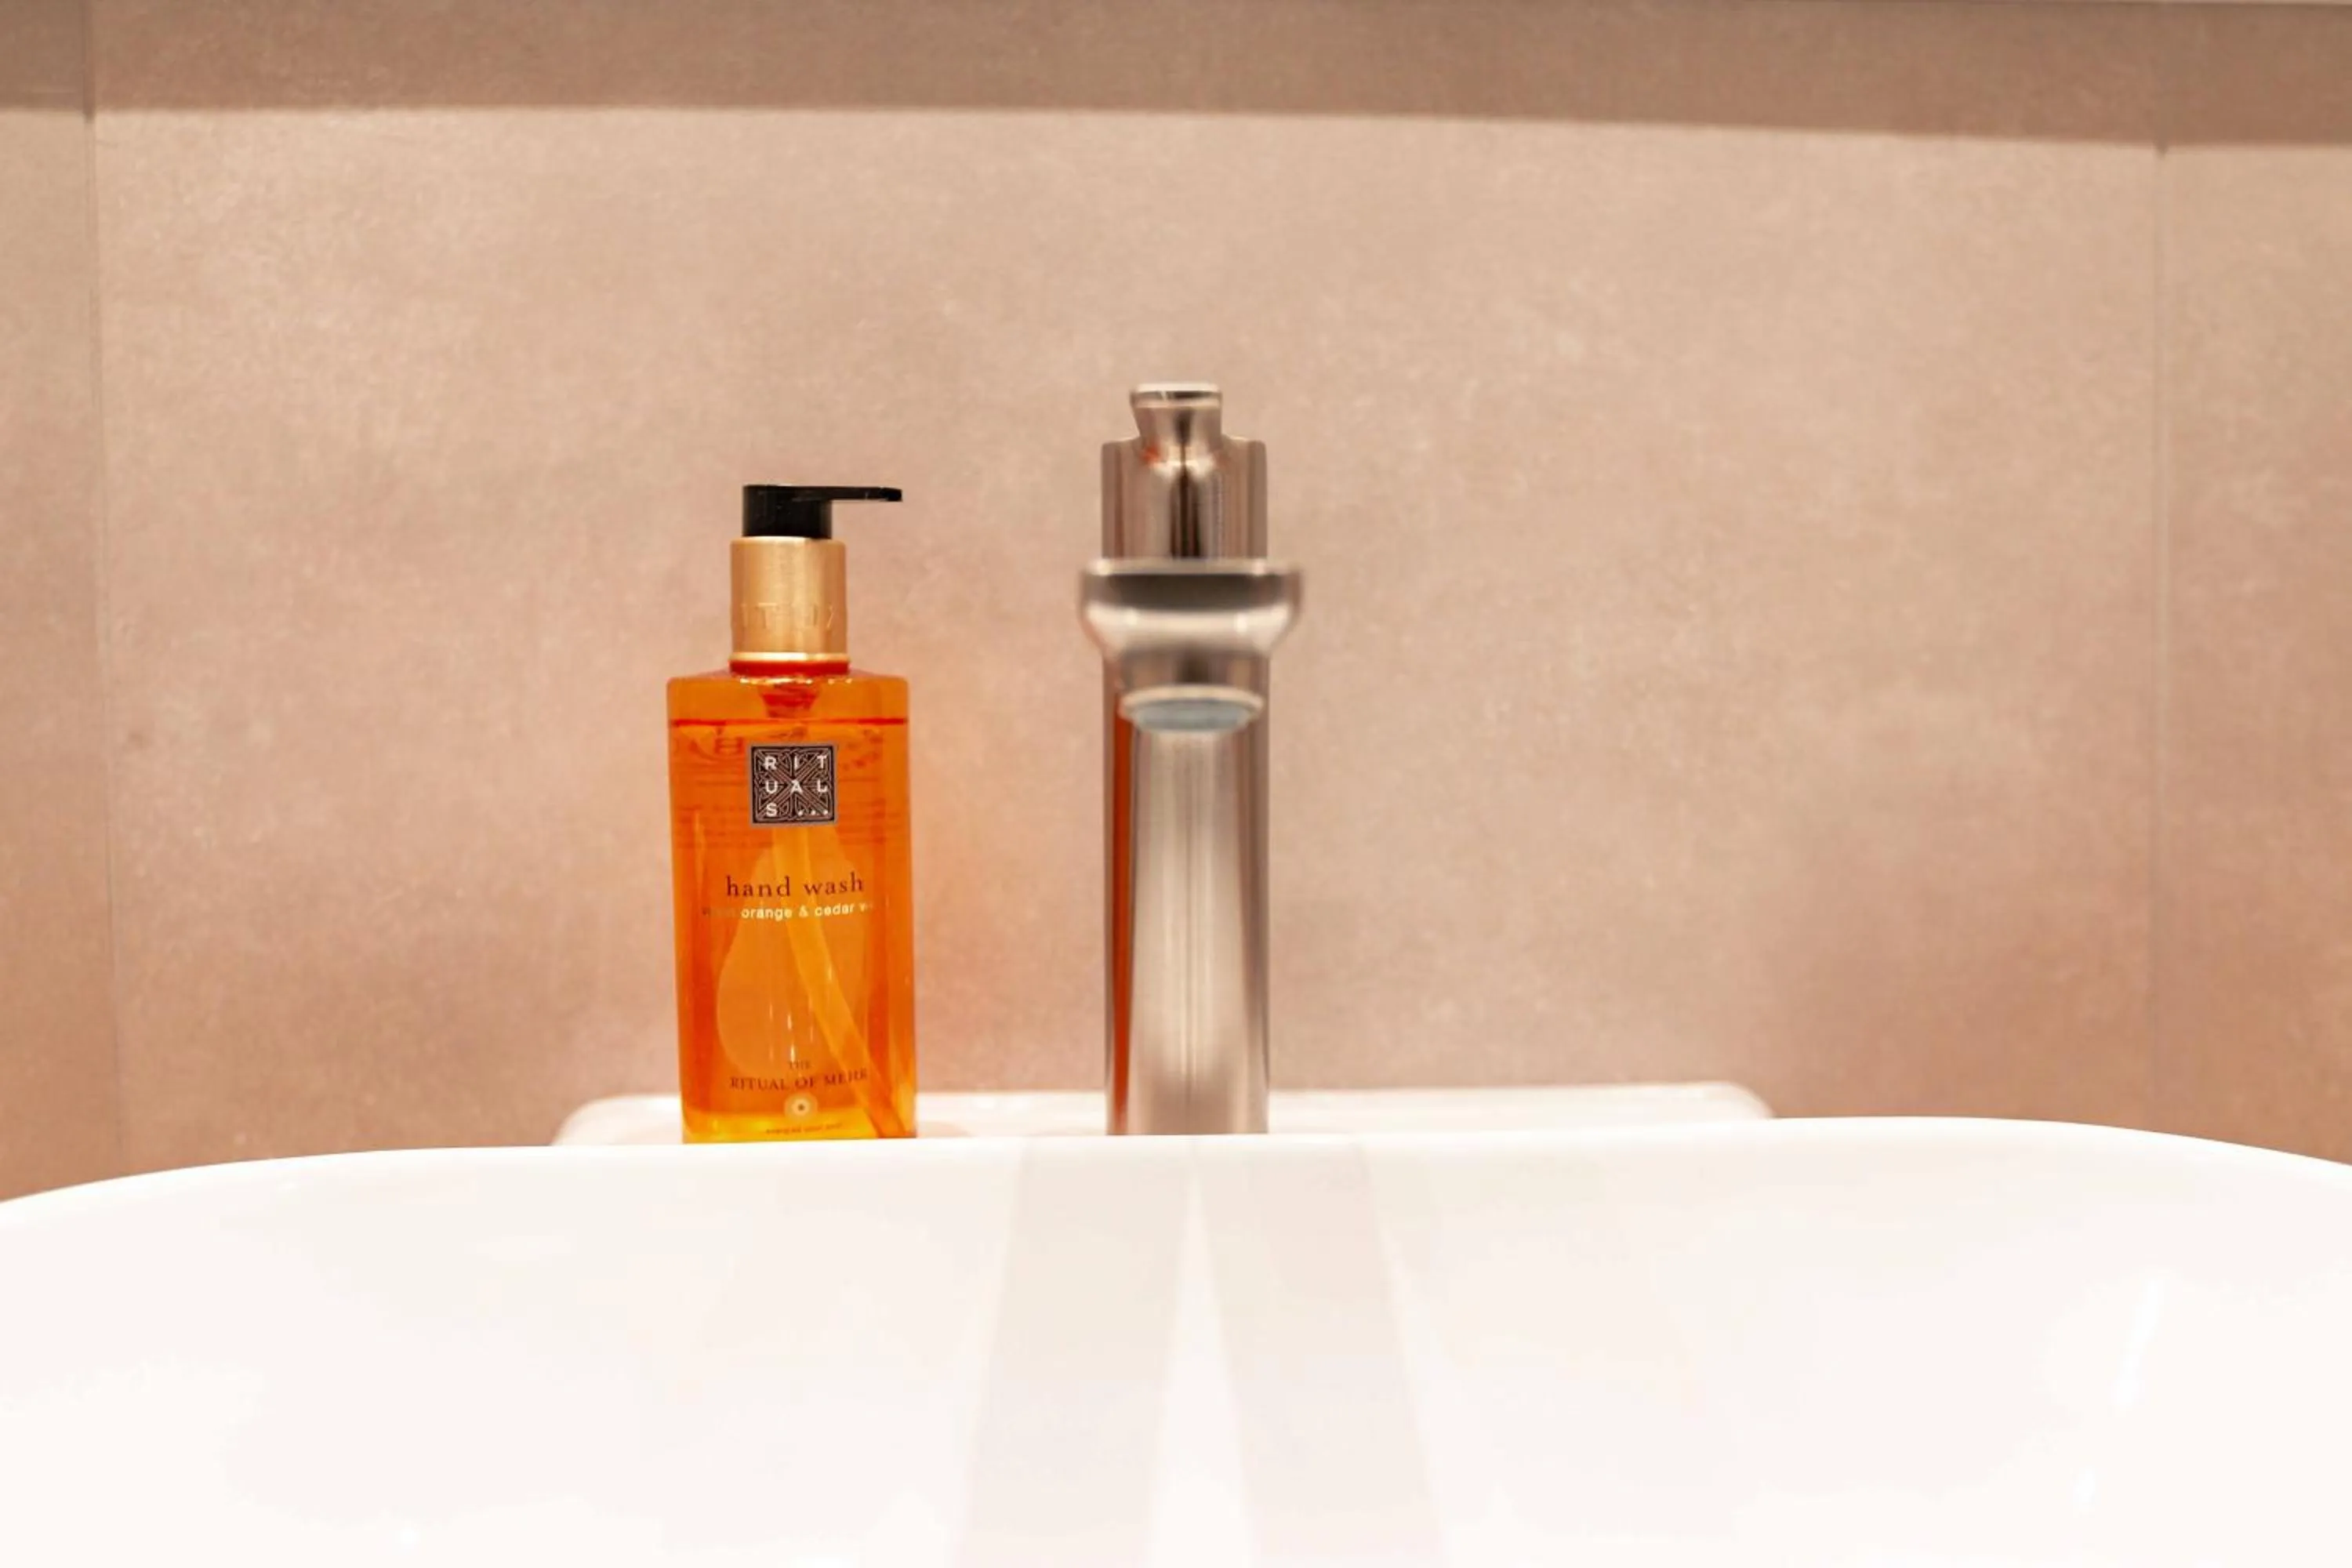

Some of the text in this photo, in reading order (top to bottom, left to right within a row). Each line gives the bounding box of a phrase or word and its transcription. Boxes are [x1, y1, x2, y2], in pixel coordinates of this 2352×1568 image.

[727, 872, 863, 897] hand wash
[741, 906, 793, 921] orange
[798, 905, 808, 917] &
[815, 902, 855, 916] cedar
[730, 1076, 789, 1091] RITUAL
